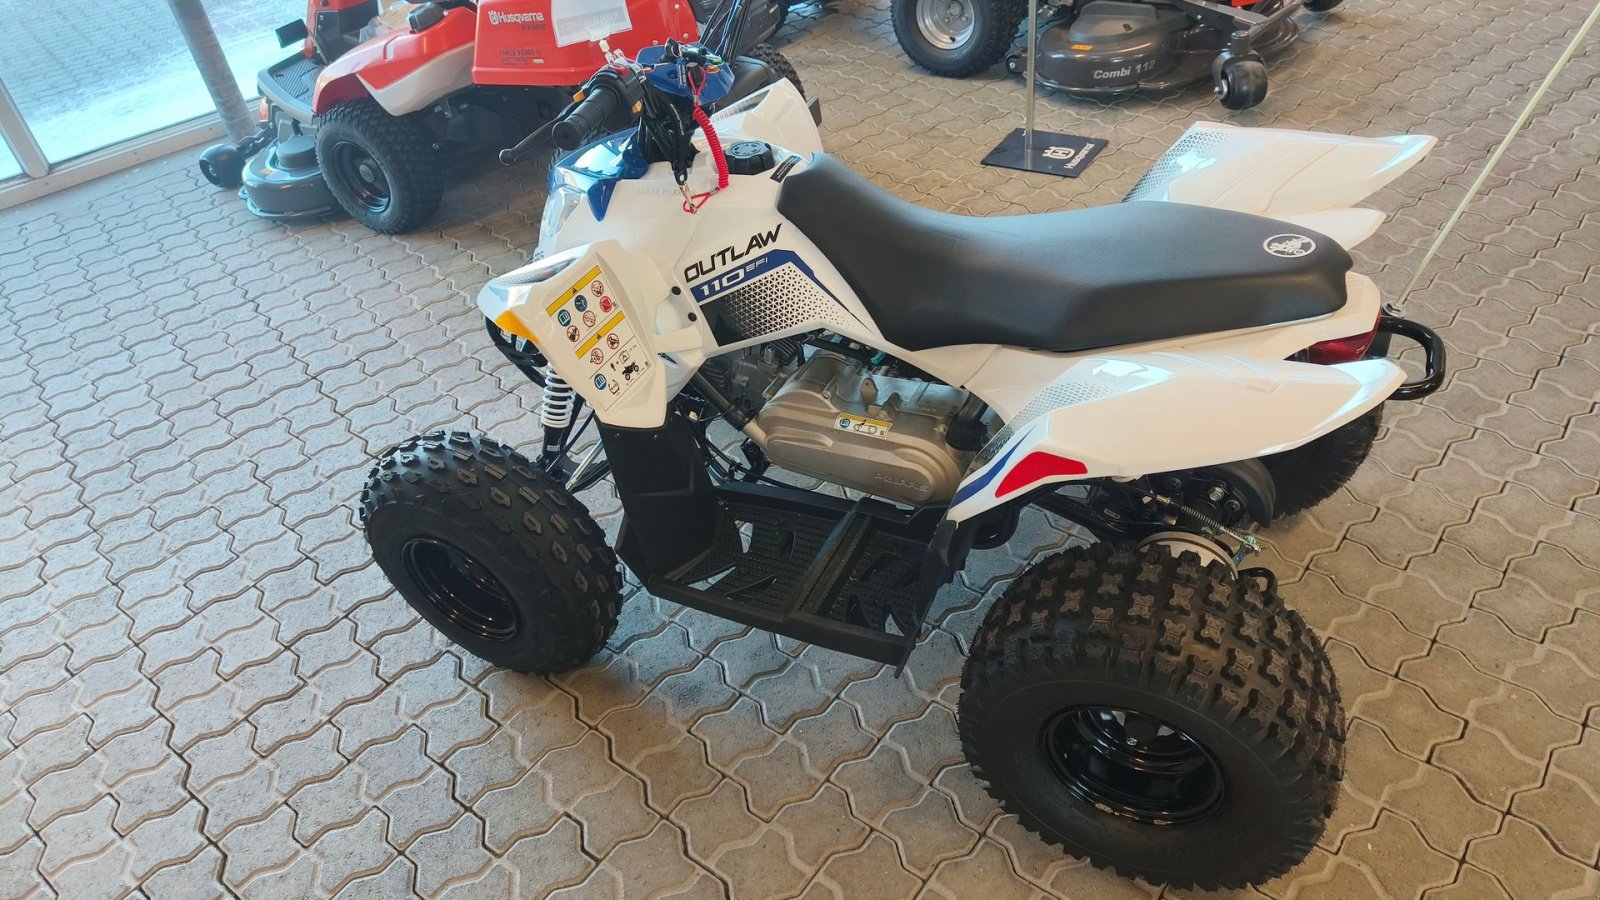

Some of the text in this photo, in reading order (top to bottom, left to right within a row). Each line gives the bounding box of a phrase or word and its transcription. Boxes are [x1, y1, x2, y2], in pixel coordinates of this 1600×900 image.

[498, 12, 545, 24] Husqvarna
[1093, 60, 1156, 79] Combi 112
[1063, 142, 1096, 169] Husqvarna
[683, 222, 783, 283] OUTLAW
[700, 257, 768, 296] 110 EFI
